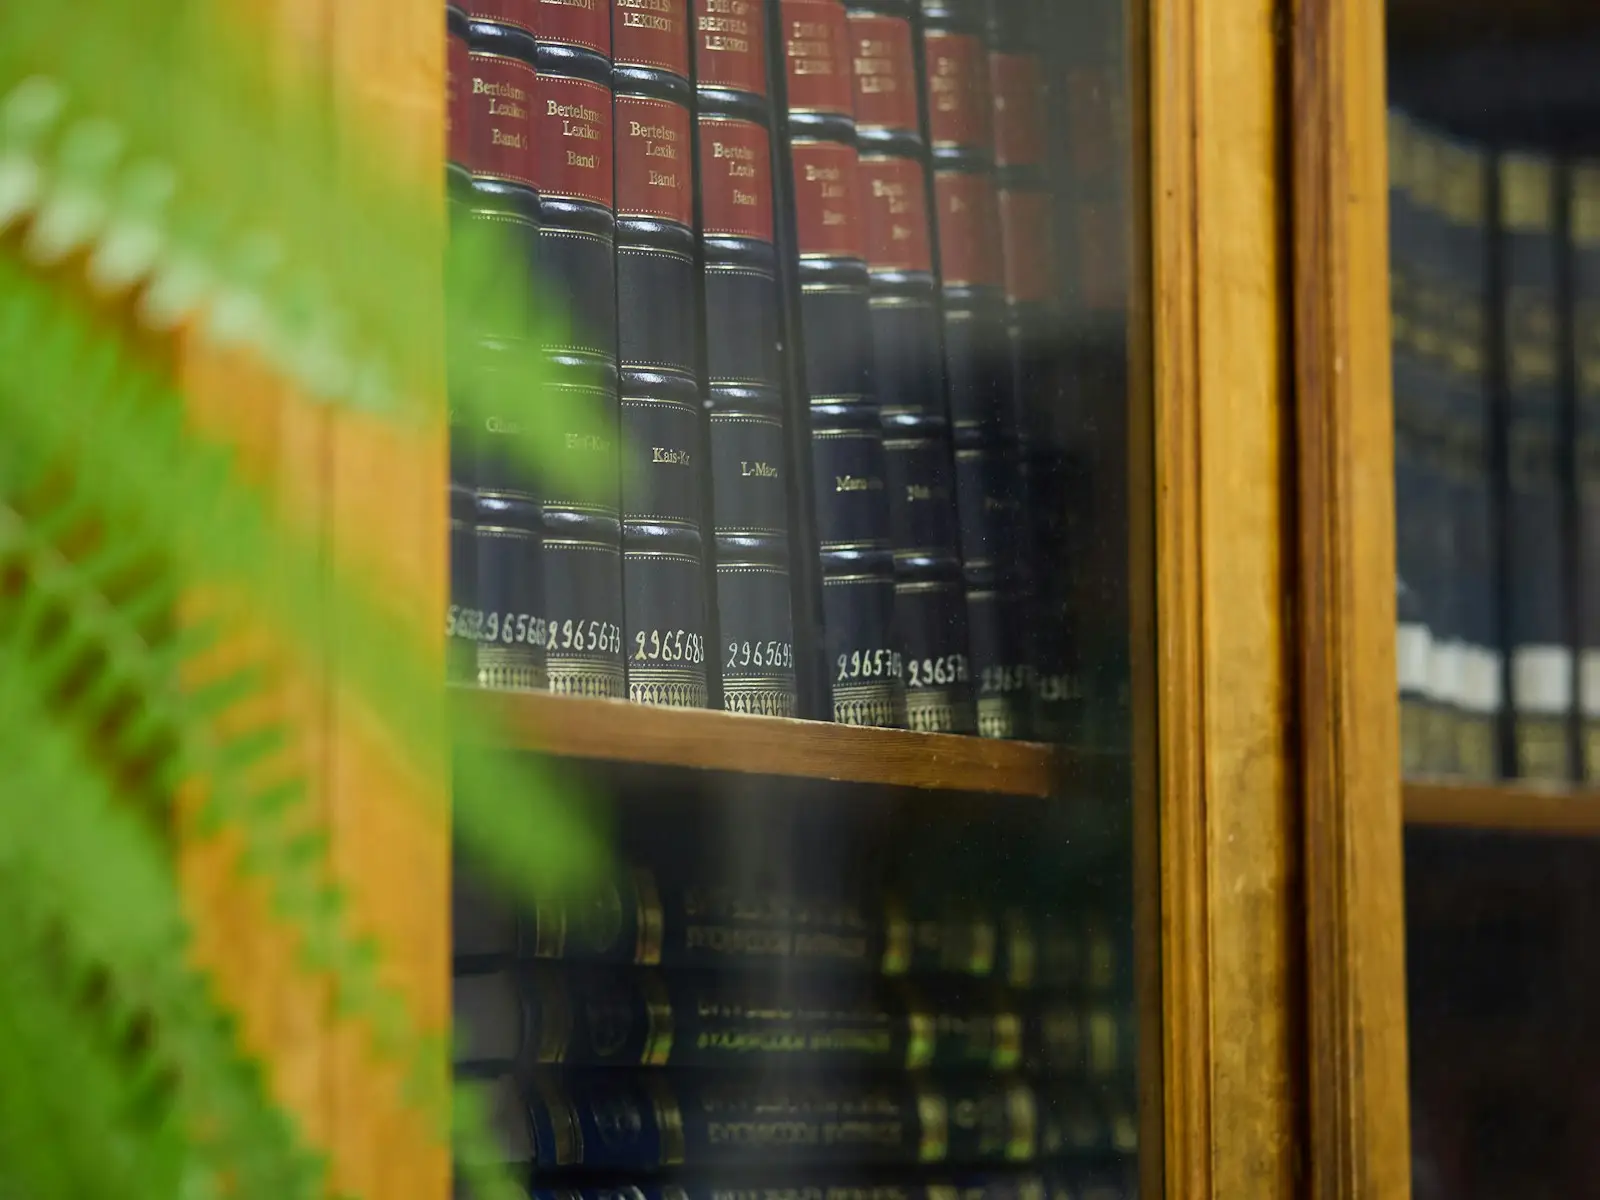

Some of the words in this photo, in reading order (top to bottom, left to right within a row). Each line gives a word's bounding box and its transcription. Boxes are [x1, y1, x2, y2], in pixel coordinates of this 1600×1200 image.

[491, 128, 521, 148] Band
[566, 150, 594, 169] Band
[648, 170, 676, 189] Band
[546, 619, 621, 654] 2965673
